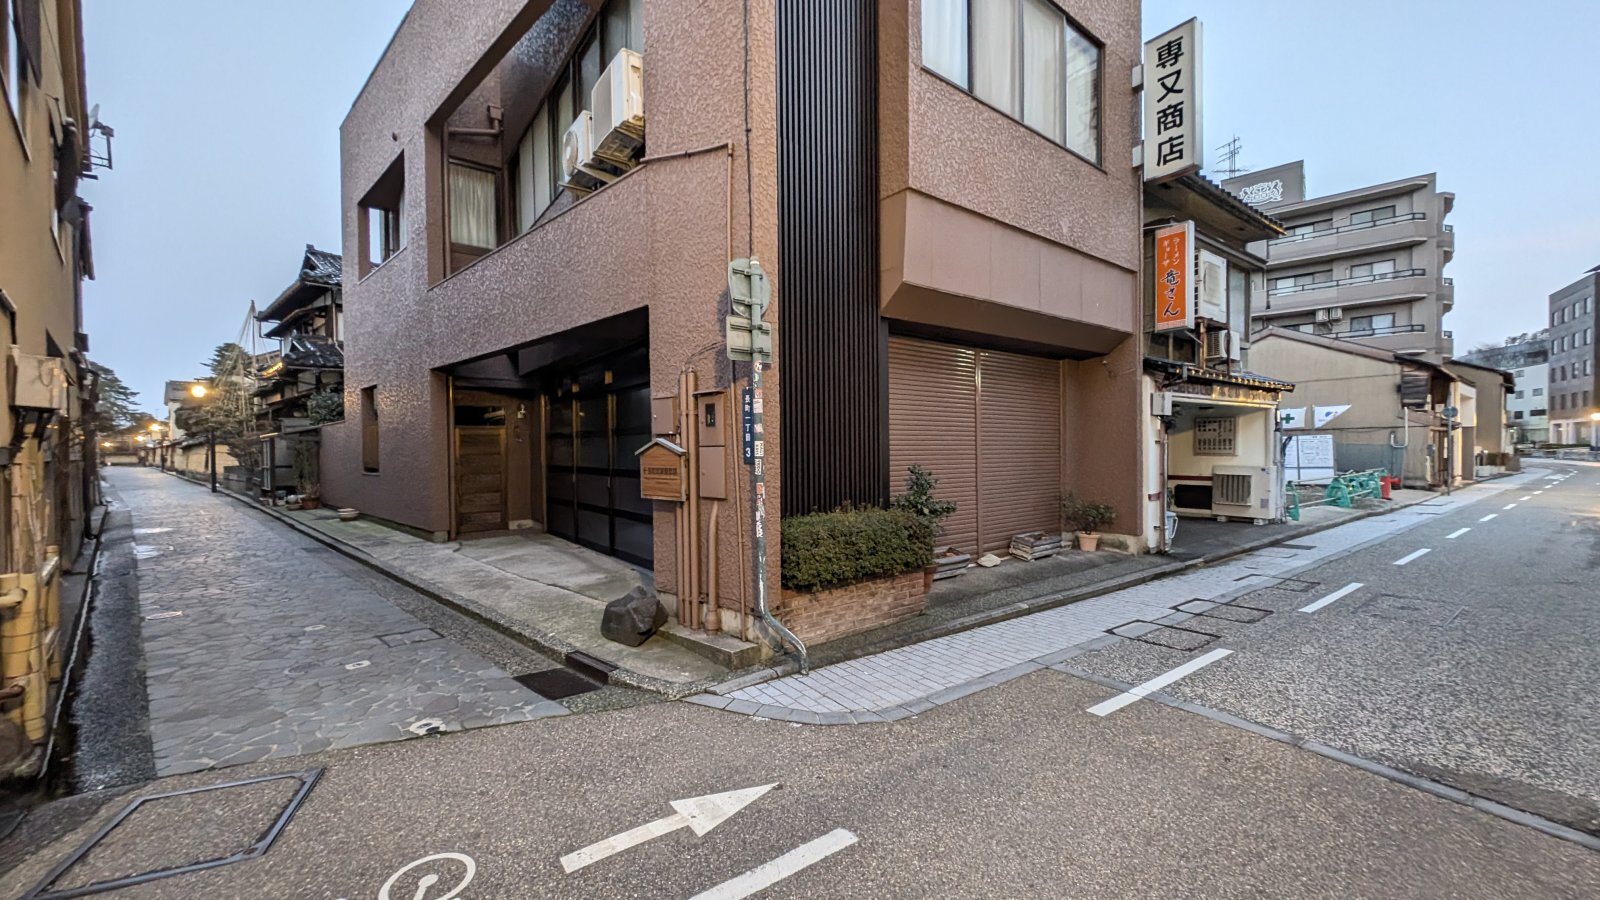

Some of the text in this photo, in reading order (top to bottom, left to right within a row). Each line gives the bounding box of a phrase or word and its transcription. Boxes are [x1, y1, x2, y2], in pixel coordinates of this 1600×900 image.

[1156, 36, 1184, 167] 専又商店
[744, 394, 752, 458] 長町一丁目 3
